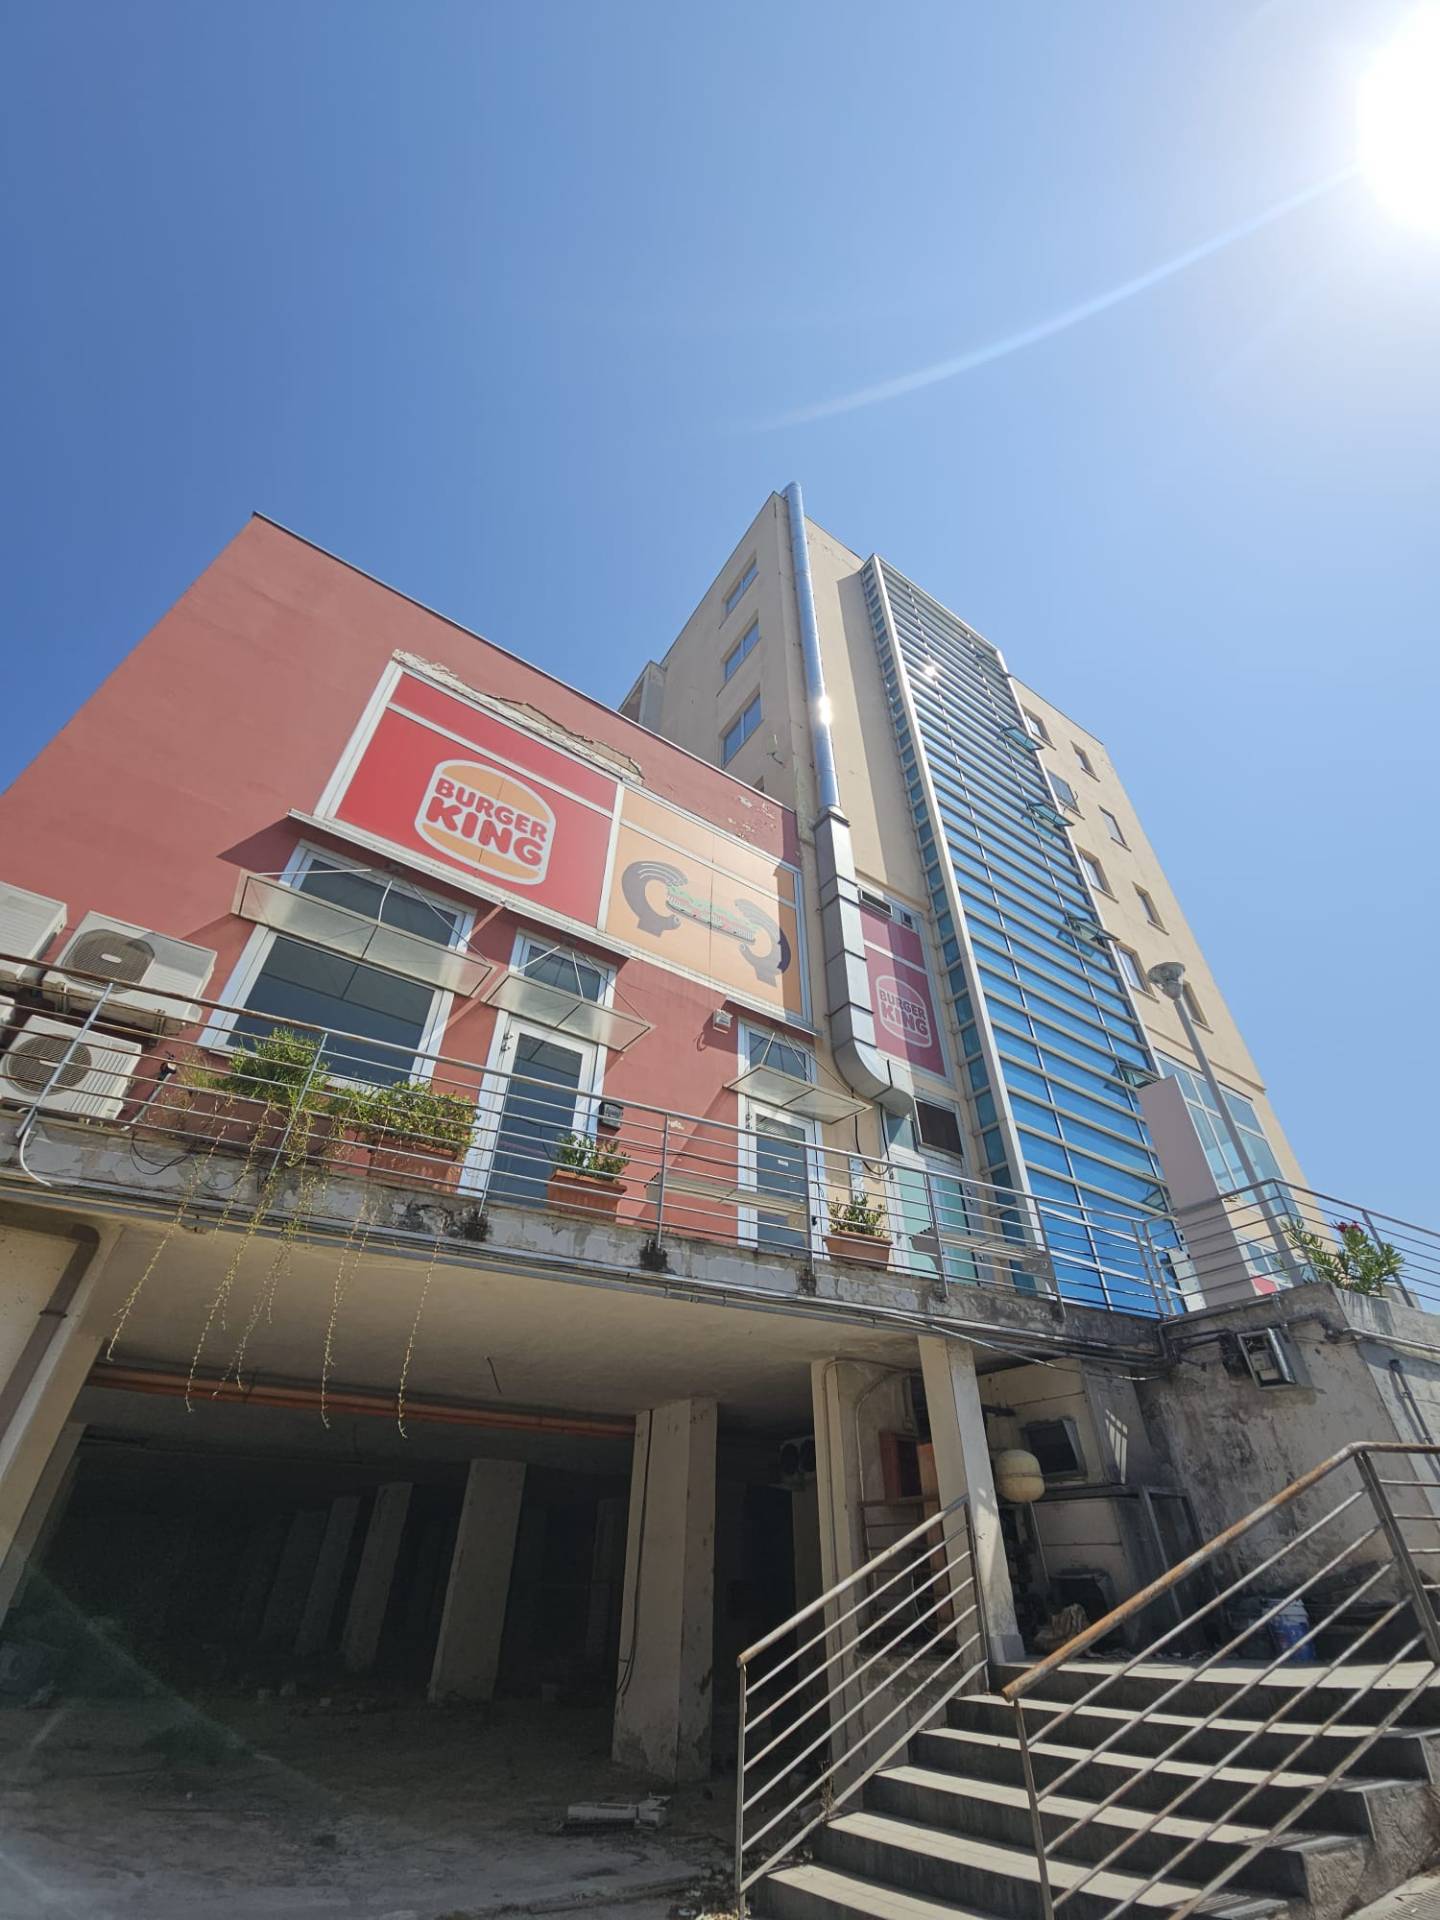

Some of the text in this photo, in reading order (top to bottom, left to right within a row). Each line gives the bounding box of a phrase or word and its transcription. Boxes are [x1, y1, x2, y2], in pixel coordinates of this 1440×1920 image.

[425, 796, 543, 866] KING
[435, 777, 547, 842] BURGER
[880, 990, 926, 1019] BURGER
[882, 1003, 928, 1036] KING
